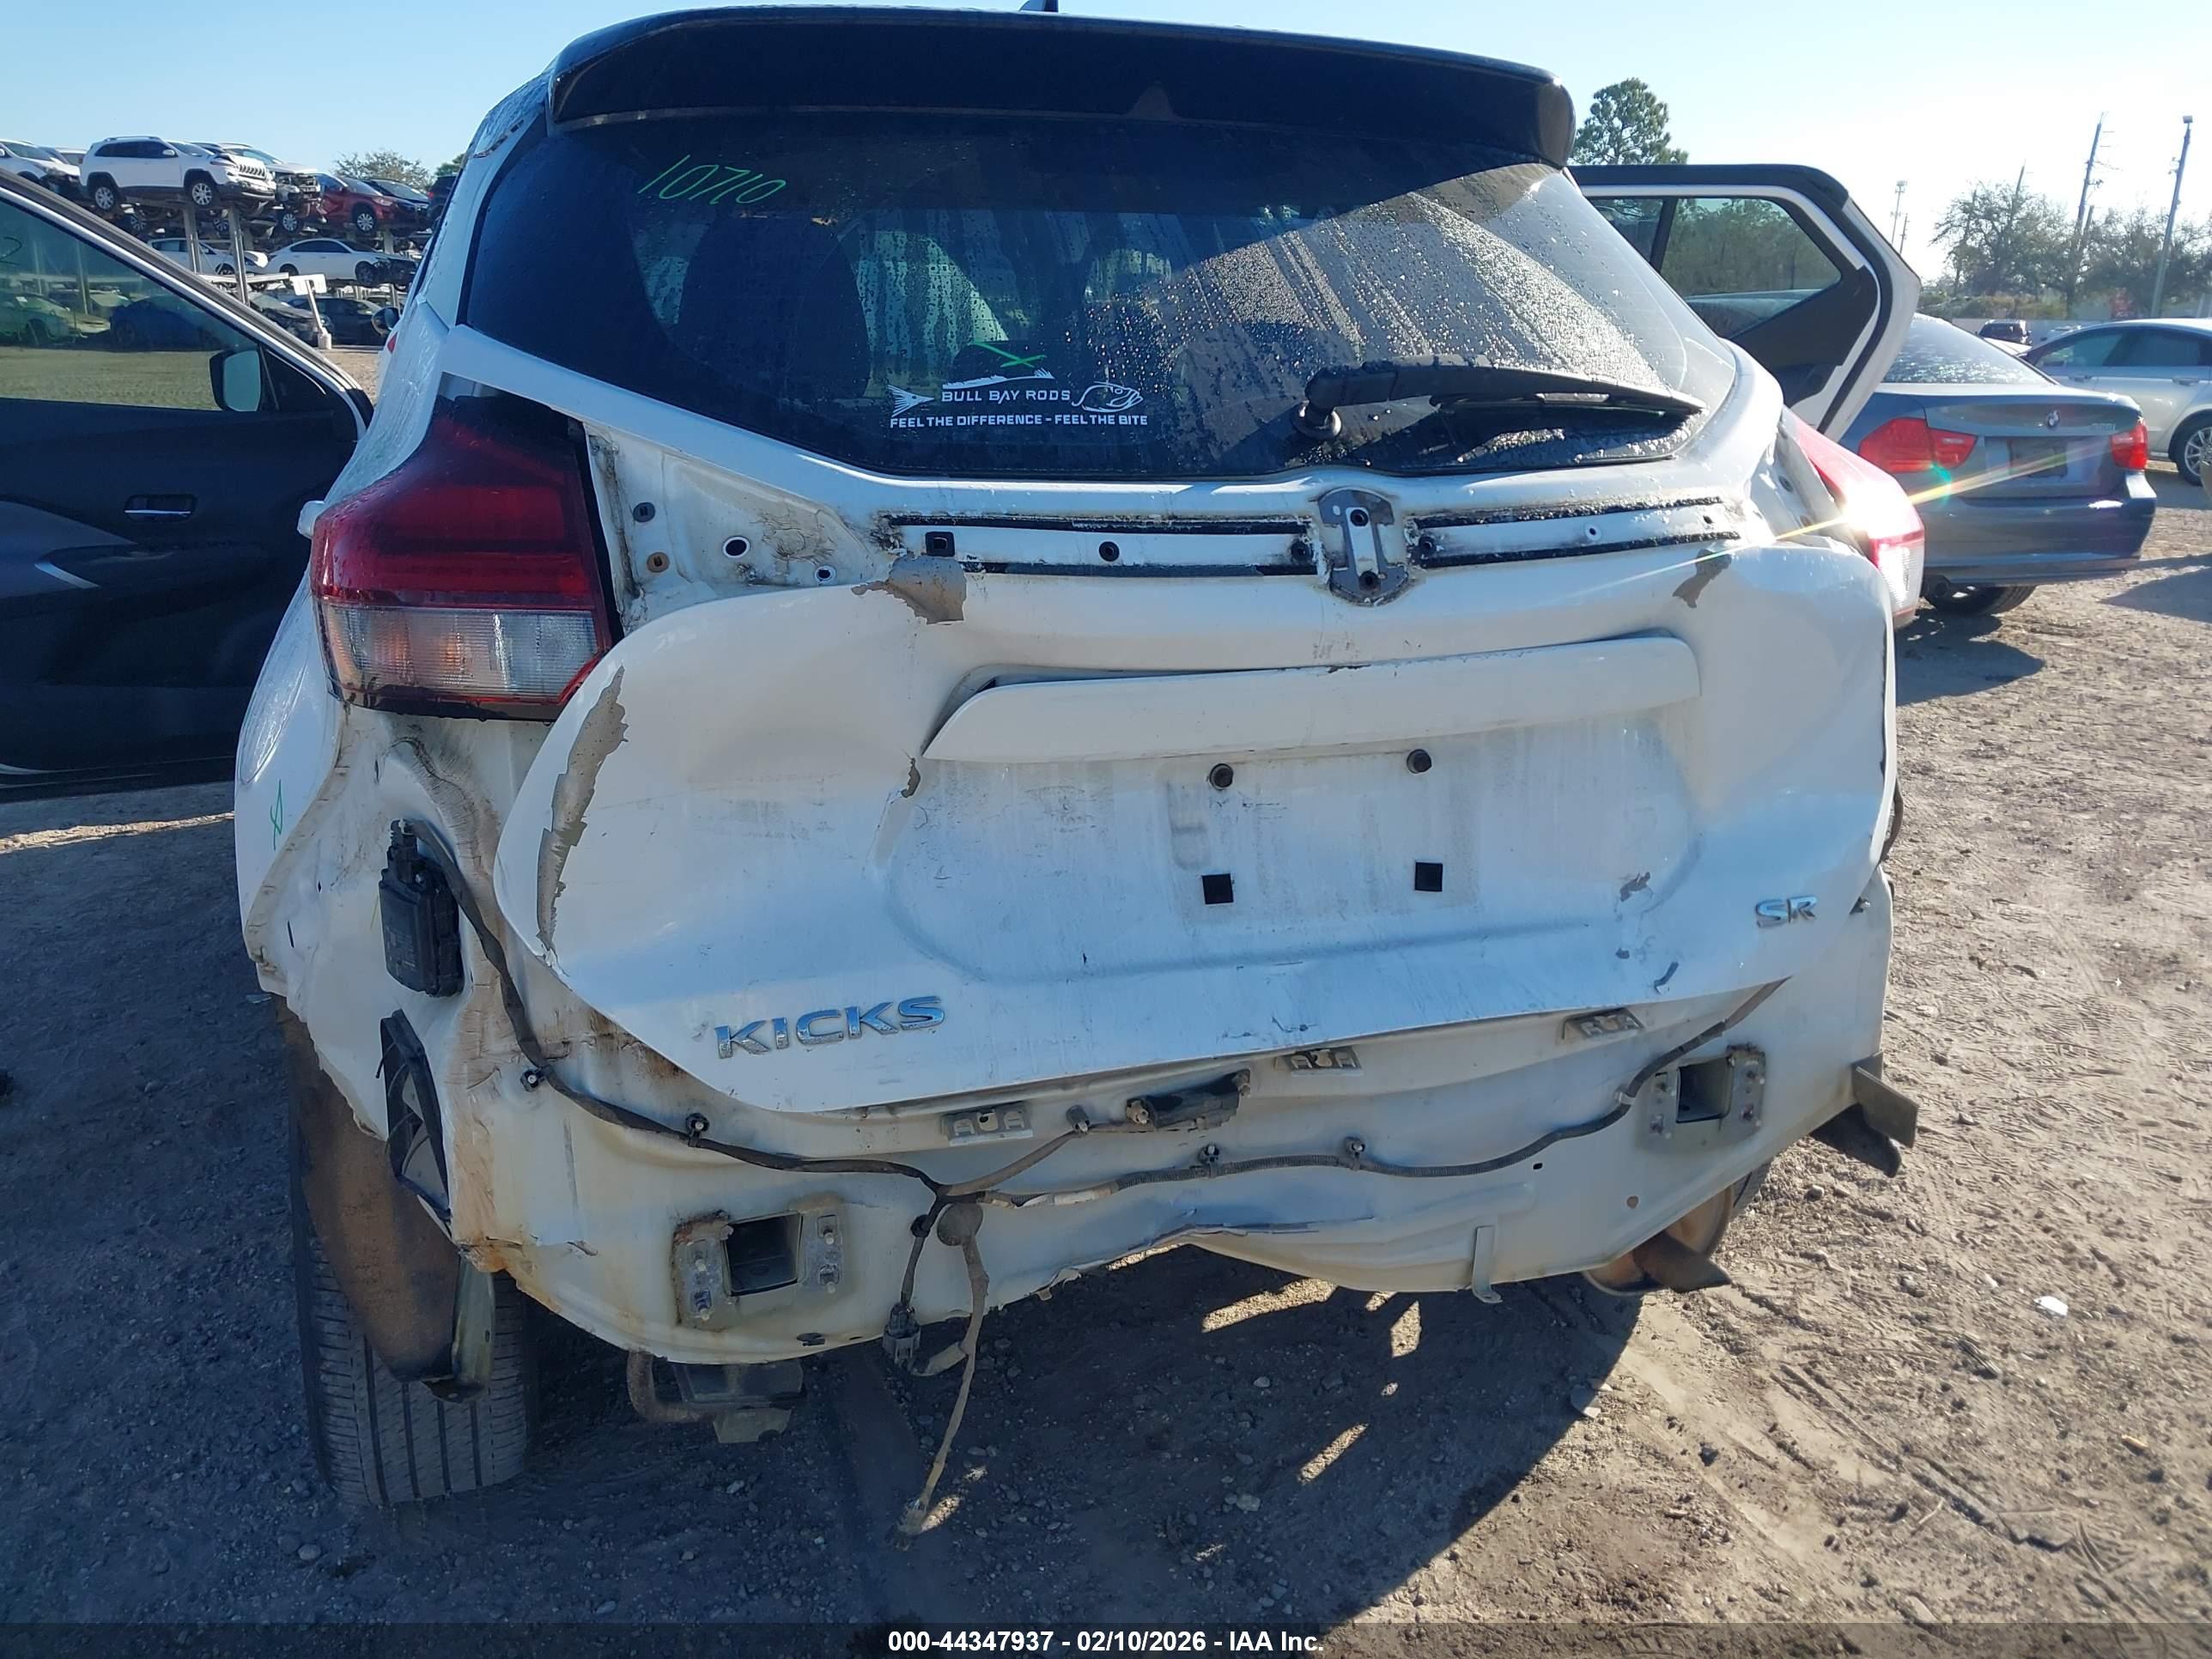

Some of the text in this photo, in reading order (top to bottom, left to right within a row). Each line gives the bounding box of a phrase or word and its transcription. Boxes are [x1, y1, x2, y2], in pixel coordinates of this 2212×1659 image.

[637, 154, 787, 204] 10710
[942, 389, 1071, 404] BULL BAY RODS
[890, 416, 925, 428] FEEL
[927, 416, 953, 428] THE
[957, 415, 1042, 427] DIFFERENCE
[1054, 415, 1088, 426] FEEL
[1089, 415, 1115, 426] THE
[1119, 415, 1148, 426] BITE
[1754, 895, 1818, 928] SR
[714, 995, 945, 1060] KICKS
